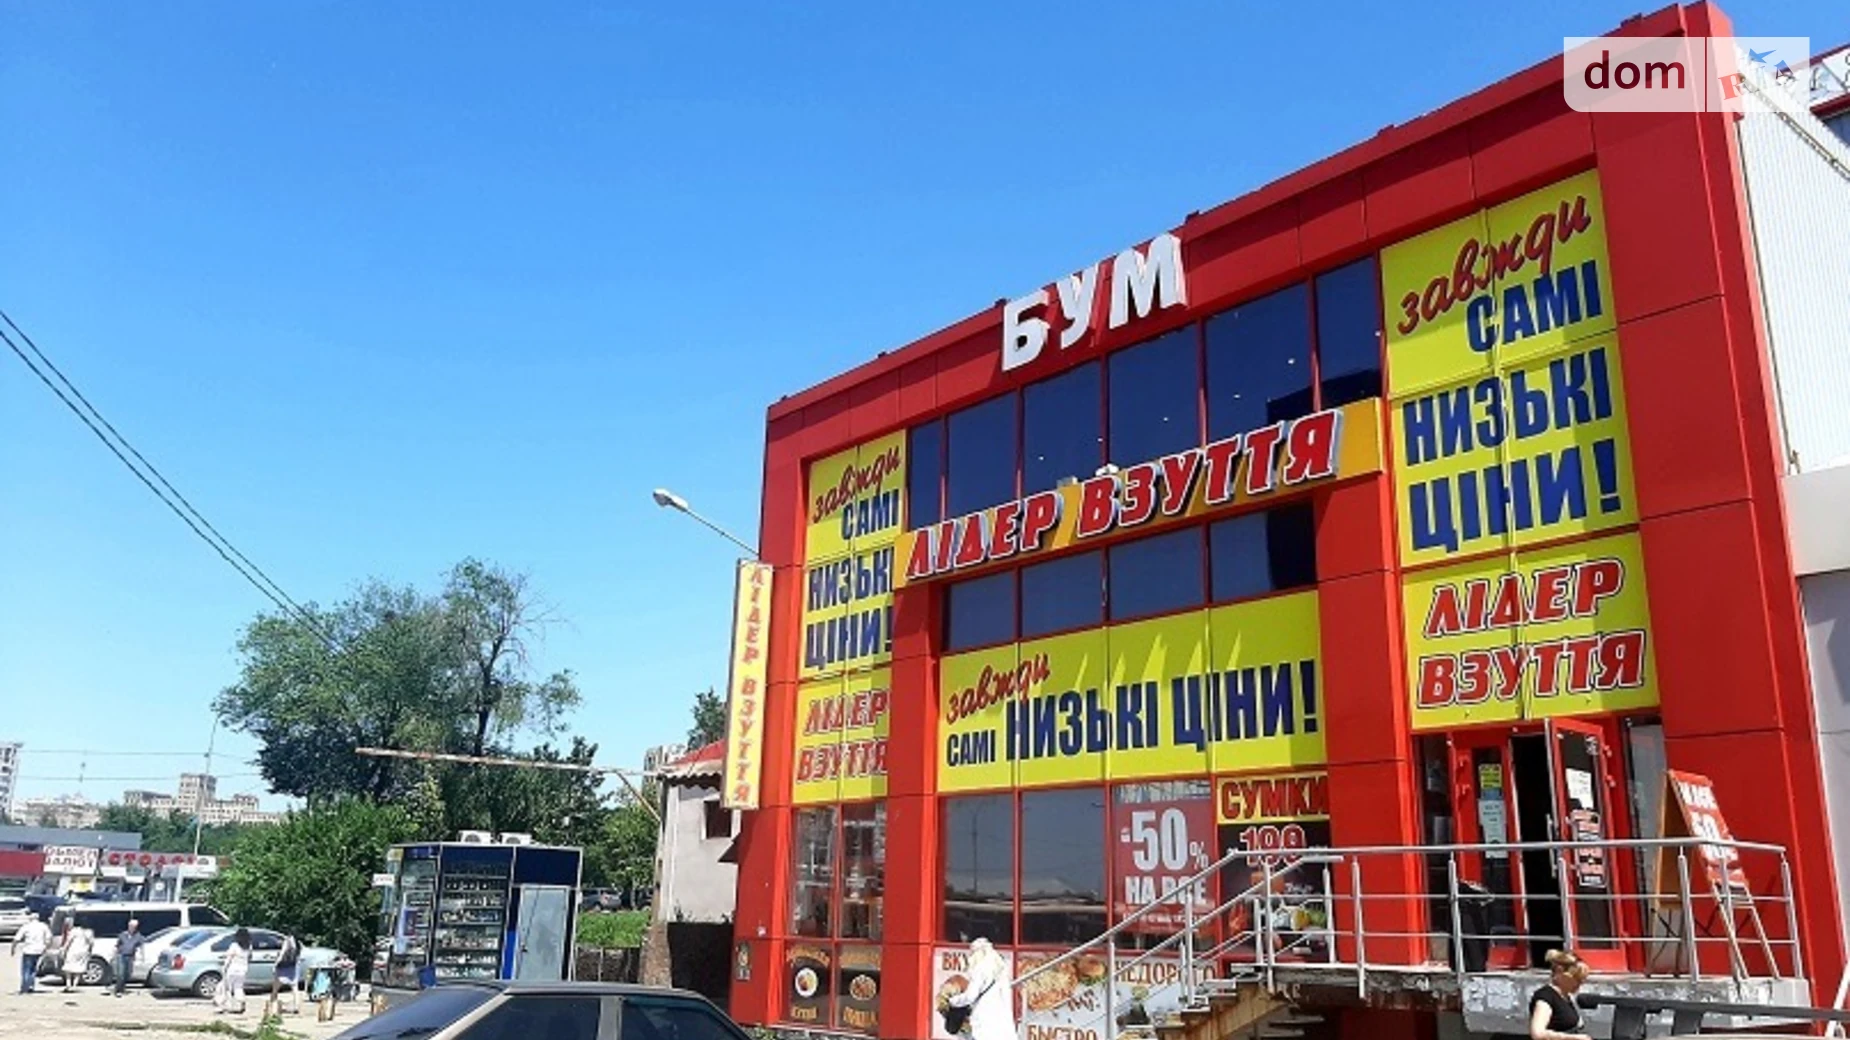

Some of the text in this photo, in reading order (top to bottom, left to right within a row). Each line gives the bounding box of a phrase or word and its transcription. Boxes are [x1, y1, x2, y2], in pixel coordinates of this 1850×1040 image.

[1002, 232, 1188, 371] БУМ
[1397, 196, 1591, 335] завжди
[1466, 259, 1603, 353] САМІ
[1402, 347, 1613, 467] НИЗЬКІ
[813, 446, 901, 523] завжди
[840, 488, 900, 540] САМІ
[905, 408, 1345, 581] ЛІДЕР ВЗУТТЯ
[1408, 438, 1622, 554] ЦІНИ!
[1423, 558, 1626, 639] ЛІДЕР
[945, 652, 1052, 726] завжди
[1416, 629, 1647, 709] ВЗУТТЯ
[803, 689, 889, 735] ЛІДЕР
[946, 659, 1319, 767] САМІ НИЗЬКІ ЦІНИ!
[1221, 775, 1330, 820] СУМКИ
[1124, 875, 1157, 905] НА
